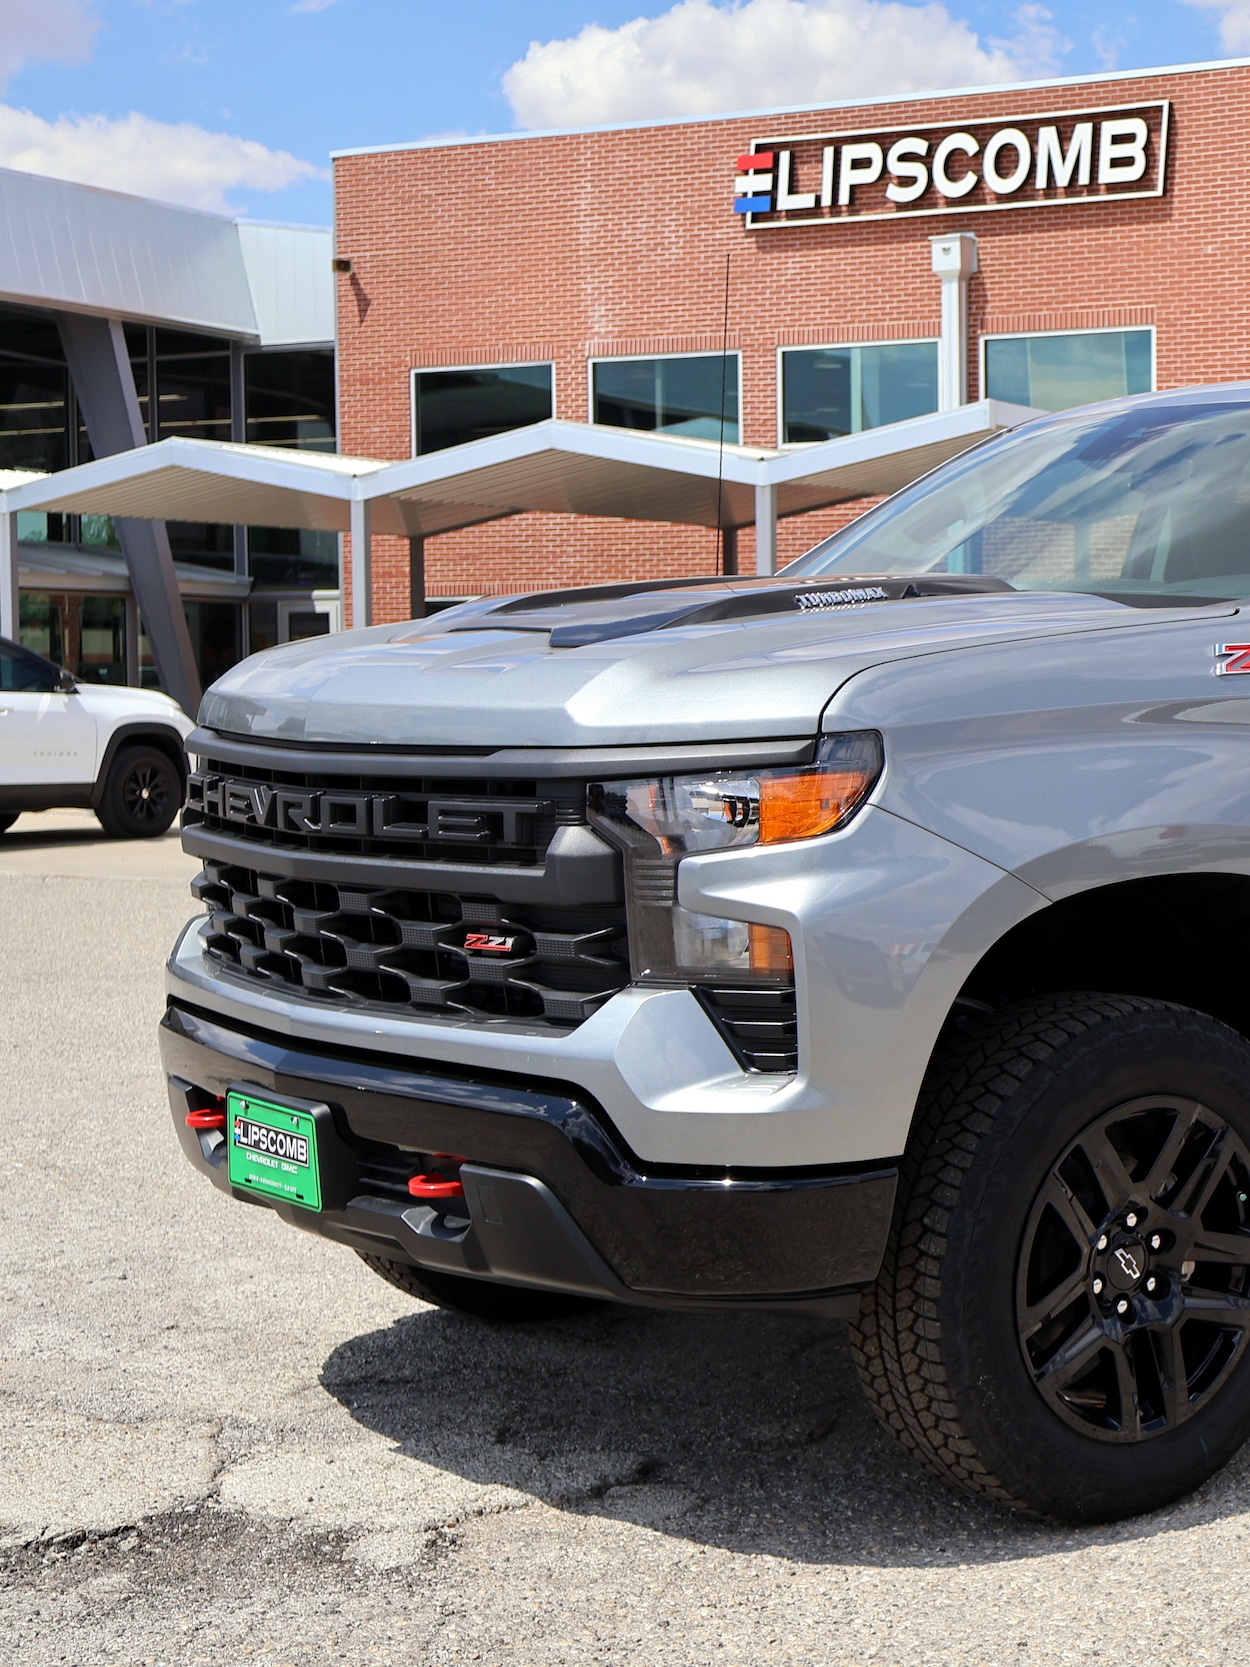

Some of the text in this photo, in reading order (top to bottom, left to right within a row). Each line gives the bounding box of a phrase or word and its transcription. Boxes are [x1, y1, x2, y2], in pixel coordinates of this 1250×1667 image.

[775, 117, 1148, 211] LIPSCOMB
[795, 586, 889, 609] TURBOMAX
[187, 773, 553, 845] CHEVROLET
[464, 933, 513, 952] Z71
[240, 1121, 307, 1161] LIPSCOMB
[246, 1152, 298, 1174] CHEVROLET GMC
